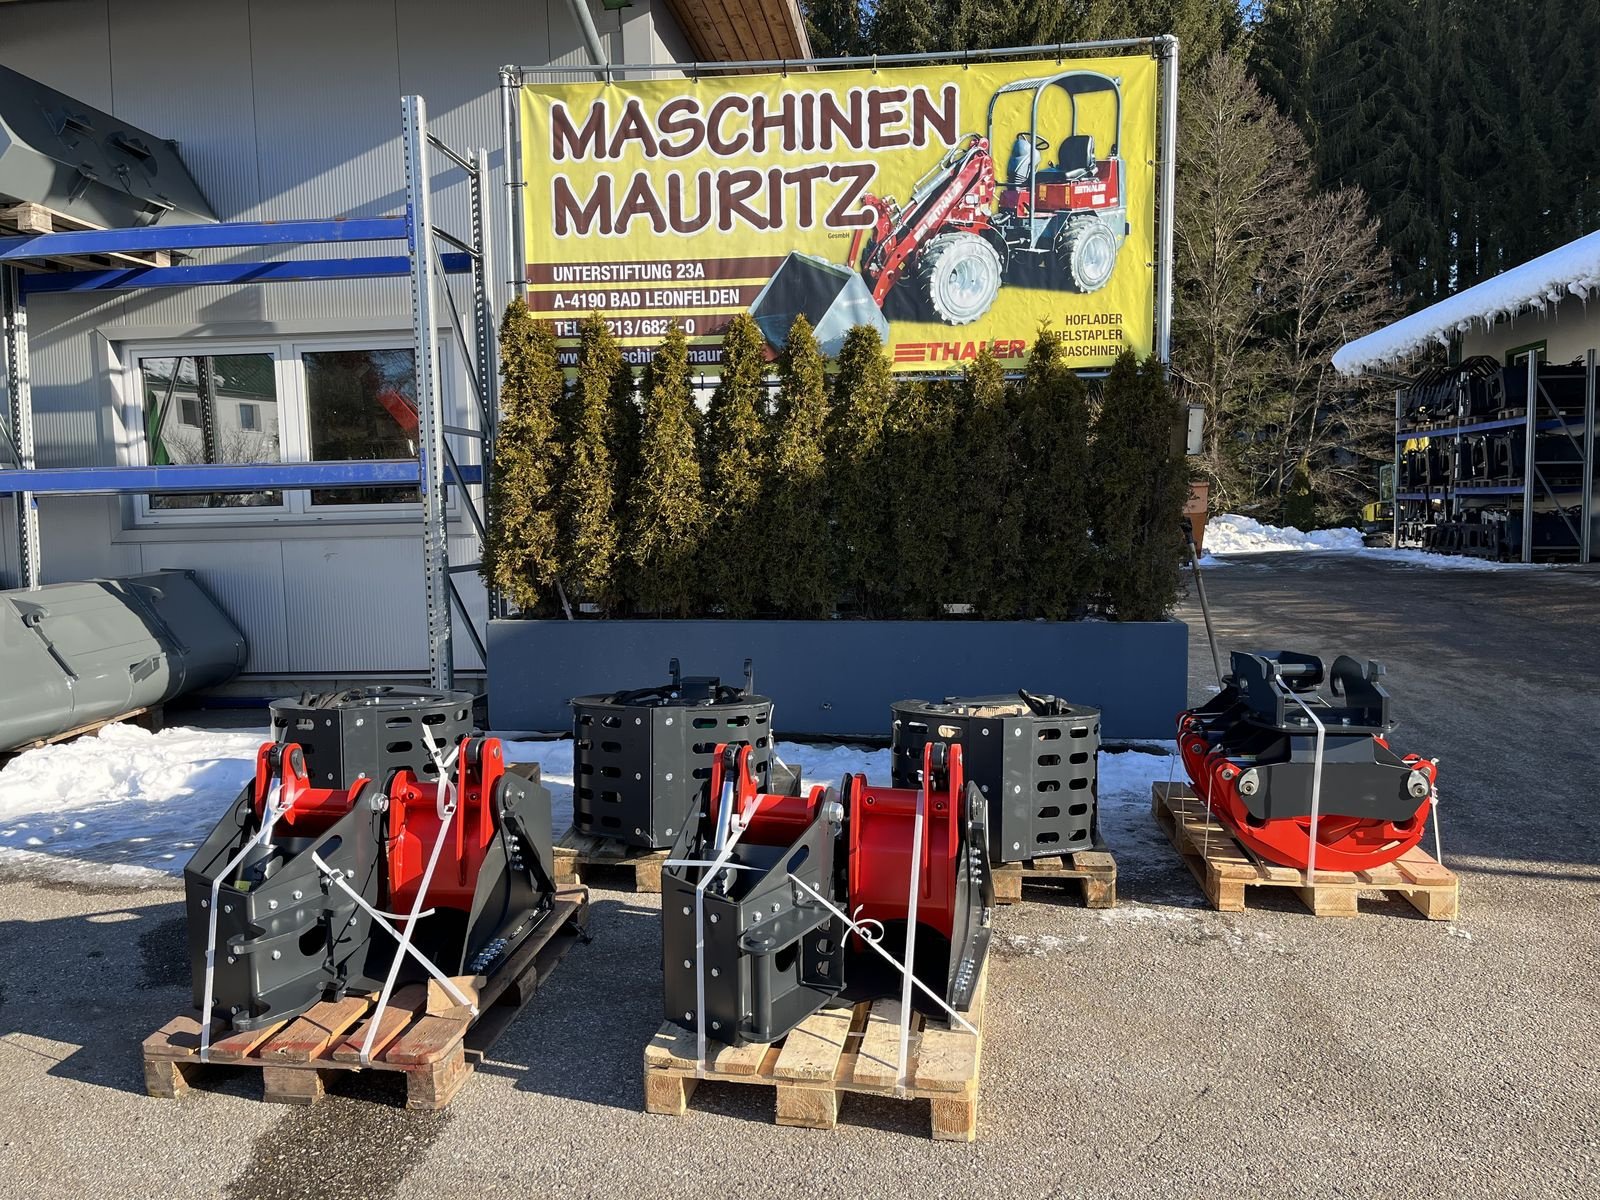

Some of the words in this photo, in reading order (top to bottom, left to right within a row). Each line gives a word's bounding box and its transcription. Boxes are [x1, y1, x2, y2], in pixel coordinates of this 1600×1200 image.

[551, 85, 958, 161] MASCHINEN
[553, 163, 877, 236] MAURITZ
[553, 264, 672, 282] UNTERSTIFTUNG
[676, 262, 705, 279] 23A
[553, 293, 606, 309] A-4190
[610, 291, 641, 308] BAD
[645, 288, 740, 306] LEONFELDEN
[1065, 313, 1123, 326] HOFLADER
